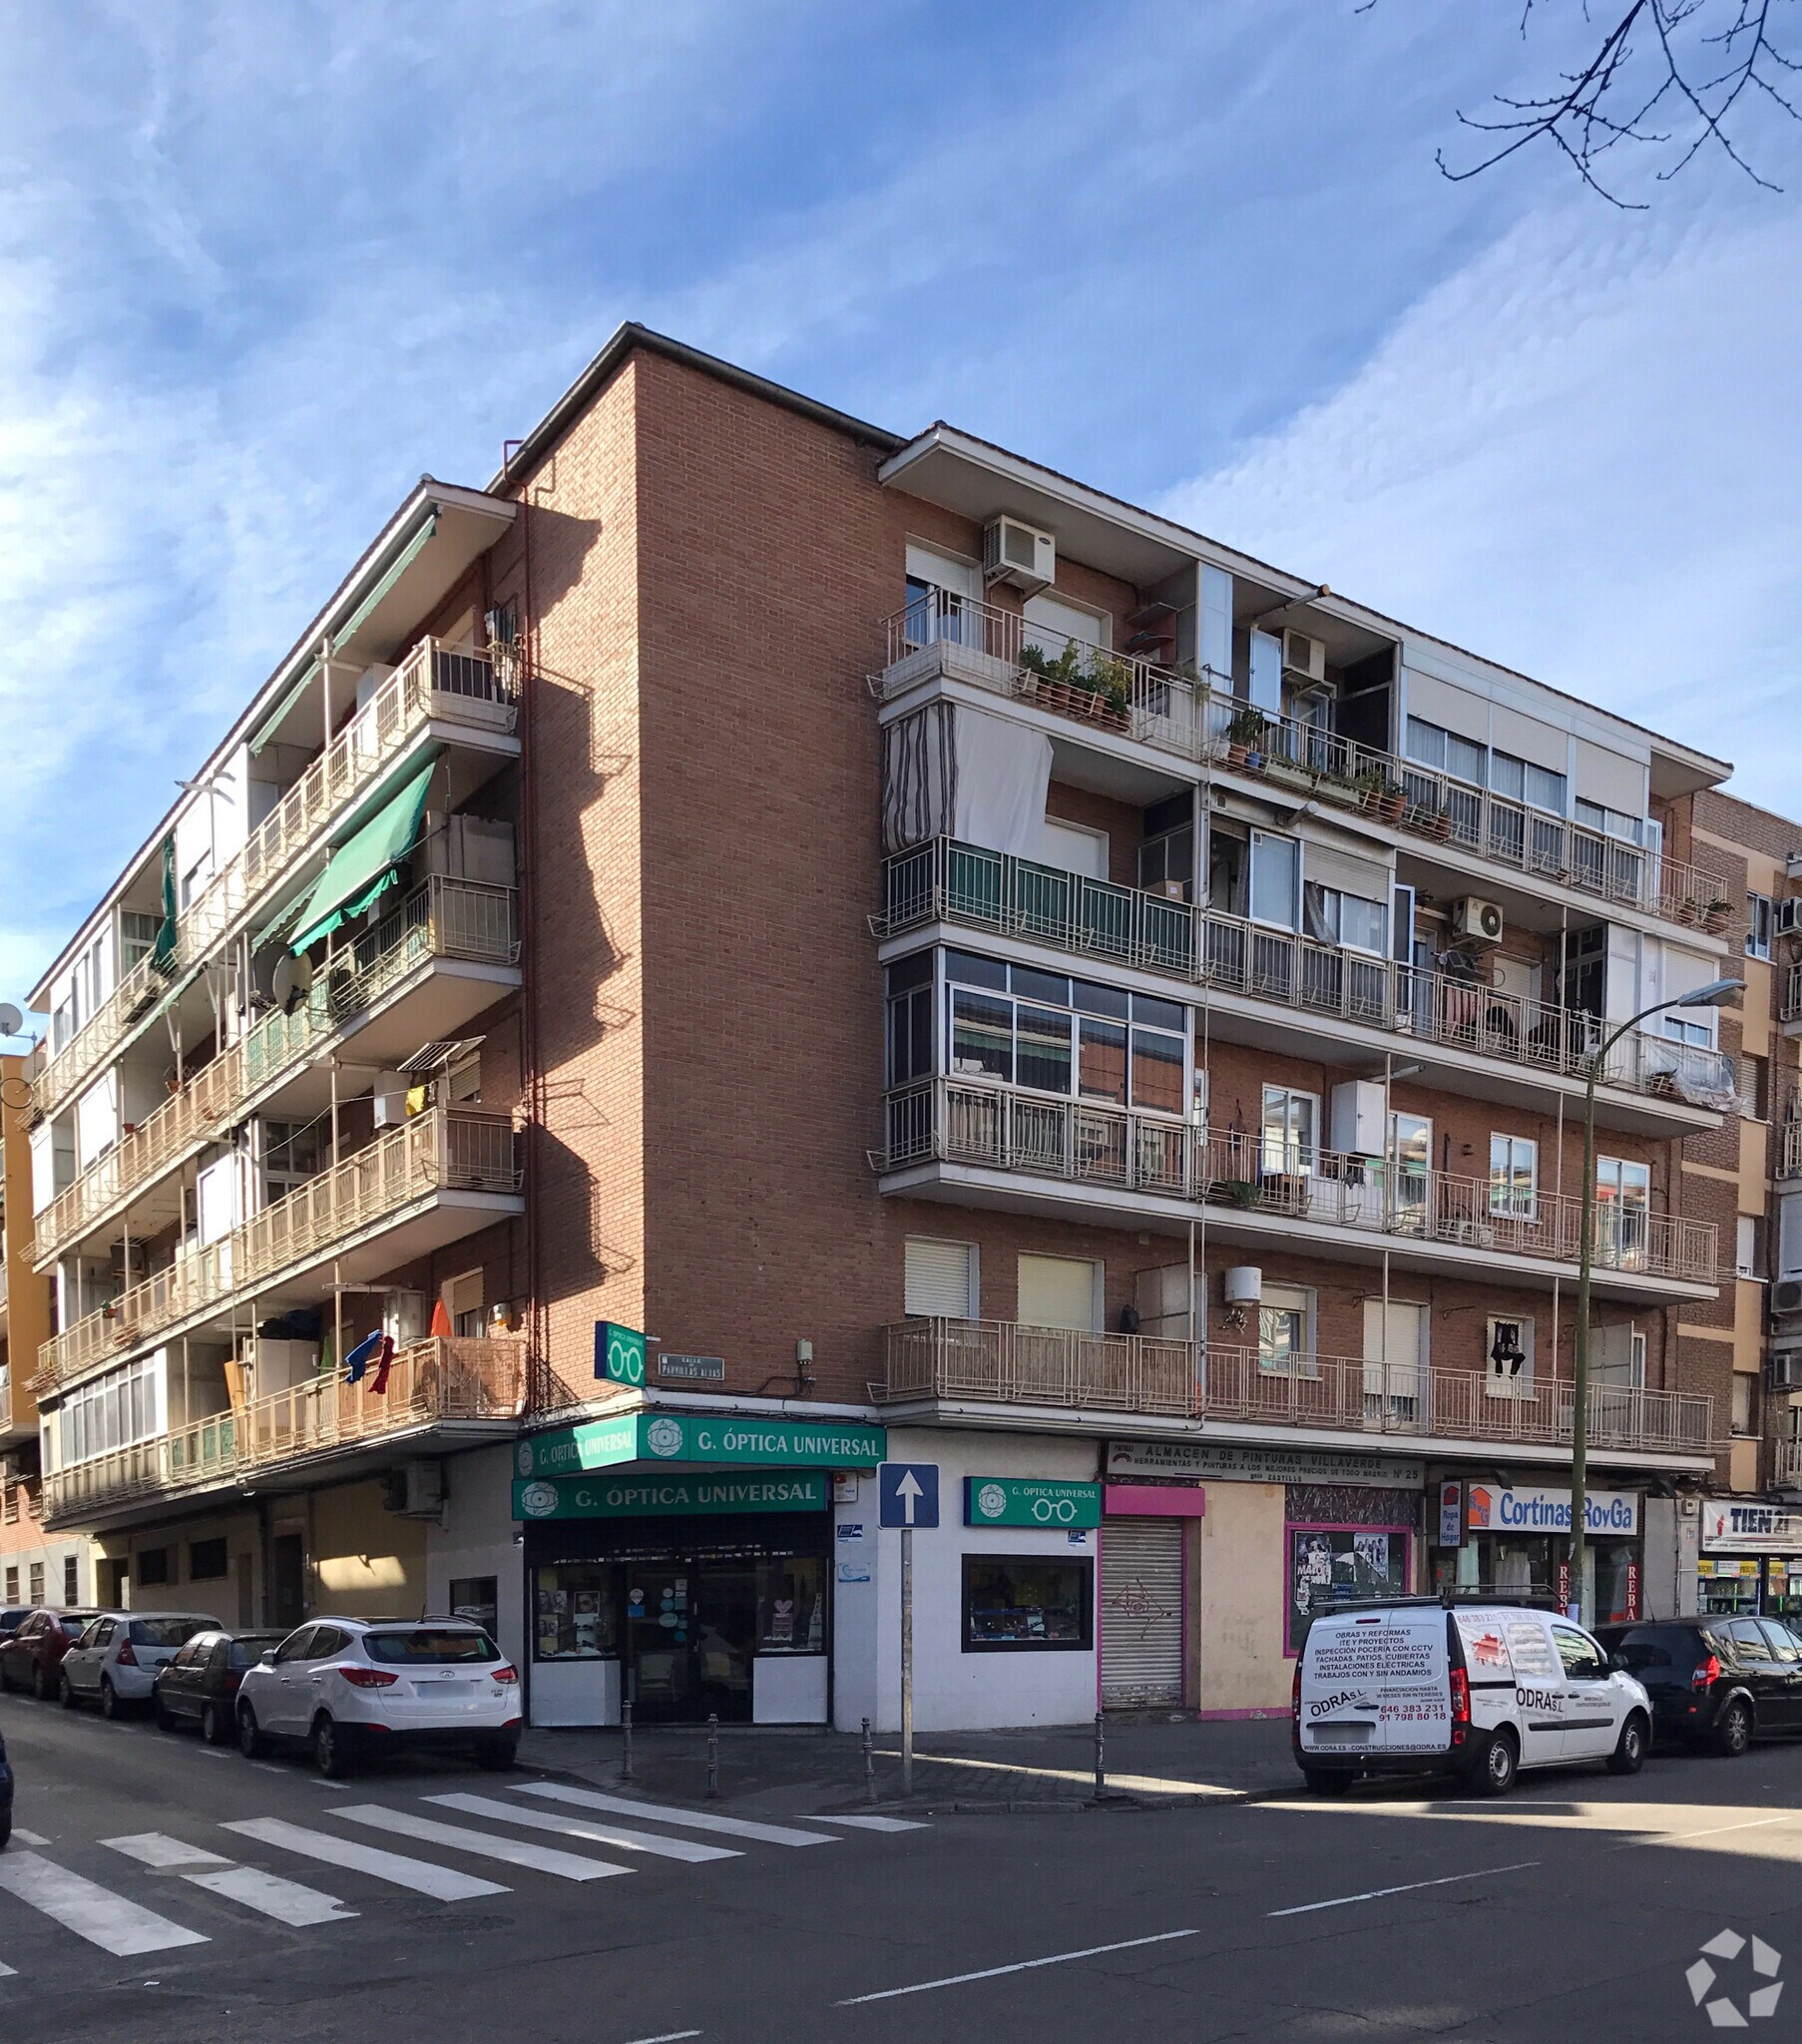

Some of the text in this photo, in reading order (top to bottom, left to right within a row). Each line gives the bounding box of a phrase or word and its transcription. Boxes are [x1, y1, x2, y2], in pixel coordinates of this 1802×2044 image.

[585, 1430, 634, 1456] UNIVERSAL
[698, 1427, 880, 1456] G. ÓPTICA UNIVERSAL
[1146, 1446, 1382, 1469] ALMACEN DE PINTURAS VILLAVERDE
[1133, 1457, 1191, 1467] HERRAMIENTAS
[1202, 1461, 1237, 1470] PINTURAS
[1405, 1469, 1419, 1480] 25
[575, 1483, 817, 1507] G. ÓPTICA UNIVERSAL
[1012, 1487, 1021, 1496] G.
[1055, 1489, 1097, 1498] UNIVERSAL
[1443, 1510, 1459, 1520] Ropa
[1500, 1492, 1573, 1527] Cortinas
[1447, 1522, 1454, 1531] de
[1441, 1533, 1460, 1544] Hogar
[1314, 1646, 1357, 1656] INSPECCIÓN
[1319, 1662, 1375, 1671] INSTALACIONES
[1314, 1671, 1351, 1680] TRABAJOS
[1380, 1705, 1400, 1714] 646
[1425, 1704, 1444, 1713] 231
